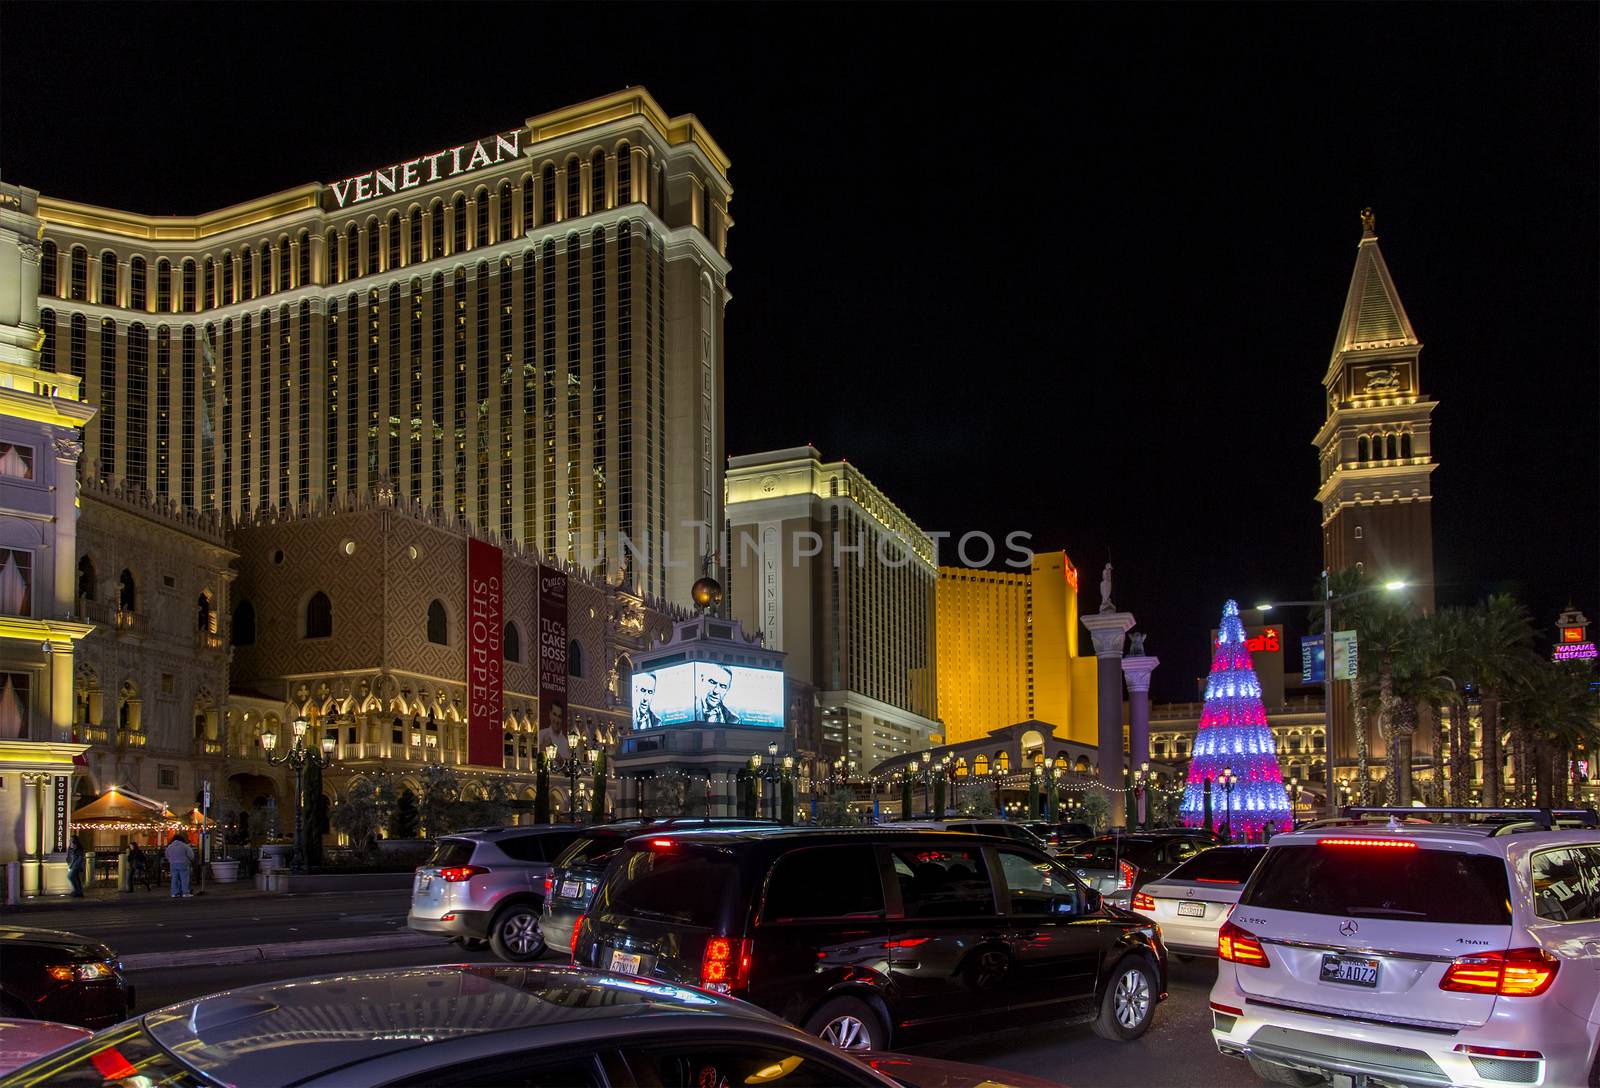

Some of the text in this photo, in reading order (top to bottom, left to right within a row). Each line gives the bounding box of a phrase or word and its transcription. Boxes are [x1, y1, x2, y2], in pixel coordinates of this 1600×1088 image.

[328, 129, 521, 208] VENETIAN
[473, 579, 488, 717] SHOPPES
[541, 632, 566, 649] CAKE
[1556, 643, 1596, 652] MADAME
[489, 577, 499, 730] GRAND CANAL
[541, 645, 566, 662] BOSS
[1348, 641, 1357, 676] LAS VEGAS
[1554, 650, 1598, 660] TUSSAUDS
[541, 658, 566, 675] NOW
[1303, 647, 1312, 681] LAS VEGAS
[542, 671, 566, 686] AT THE
